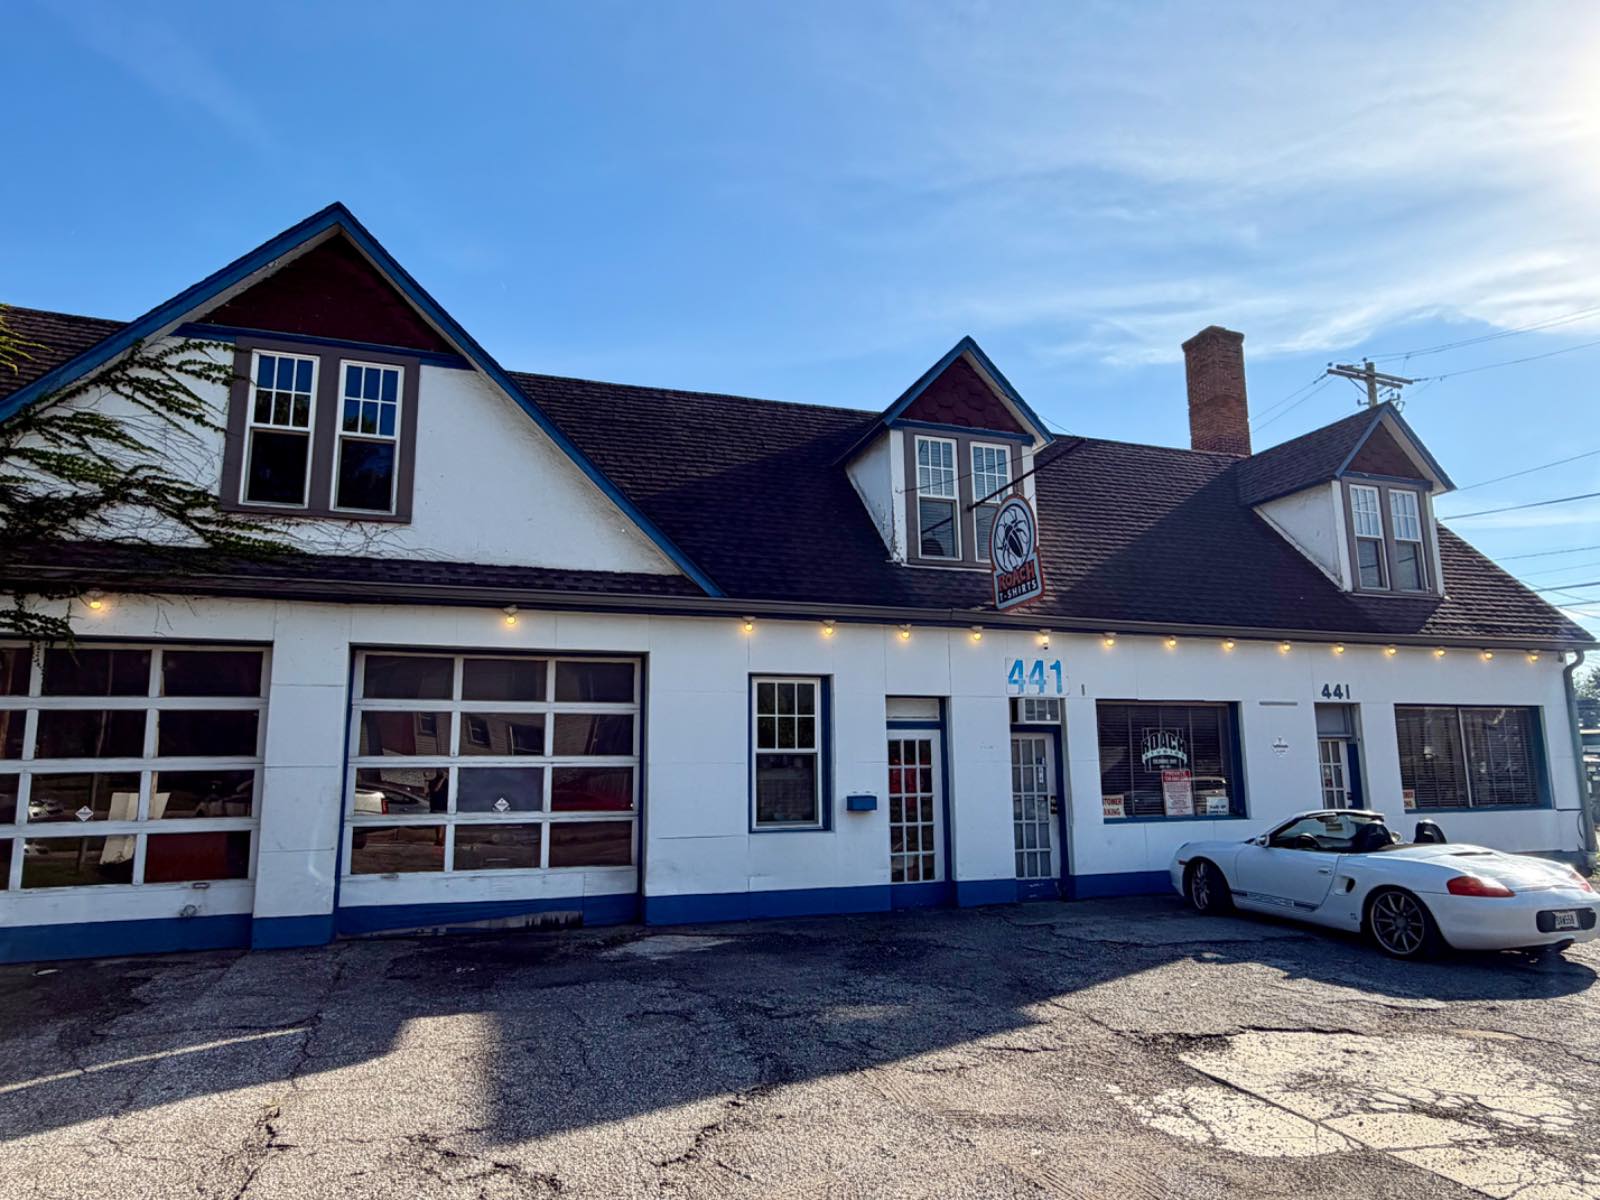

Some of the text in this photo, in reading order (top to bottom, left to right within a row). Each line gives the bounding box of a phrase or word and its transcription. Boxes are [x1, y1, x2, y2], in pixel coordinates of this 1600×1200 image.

[998, 561, 1035, 591] ROACH
[1000, 580, 1037, 601] T-SHIRTS
[1008, 659, 1063, 695] 441
[1321, 683, 1350, 700] 441
[1142, 731, 1187, 756] ROACH
